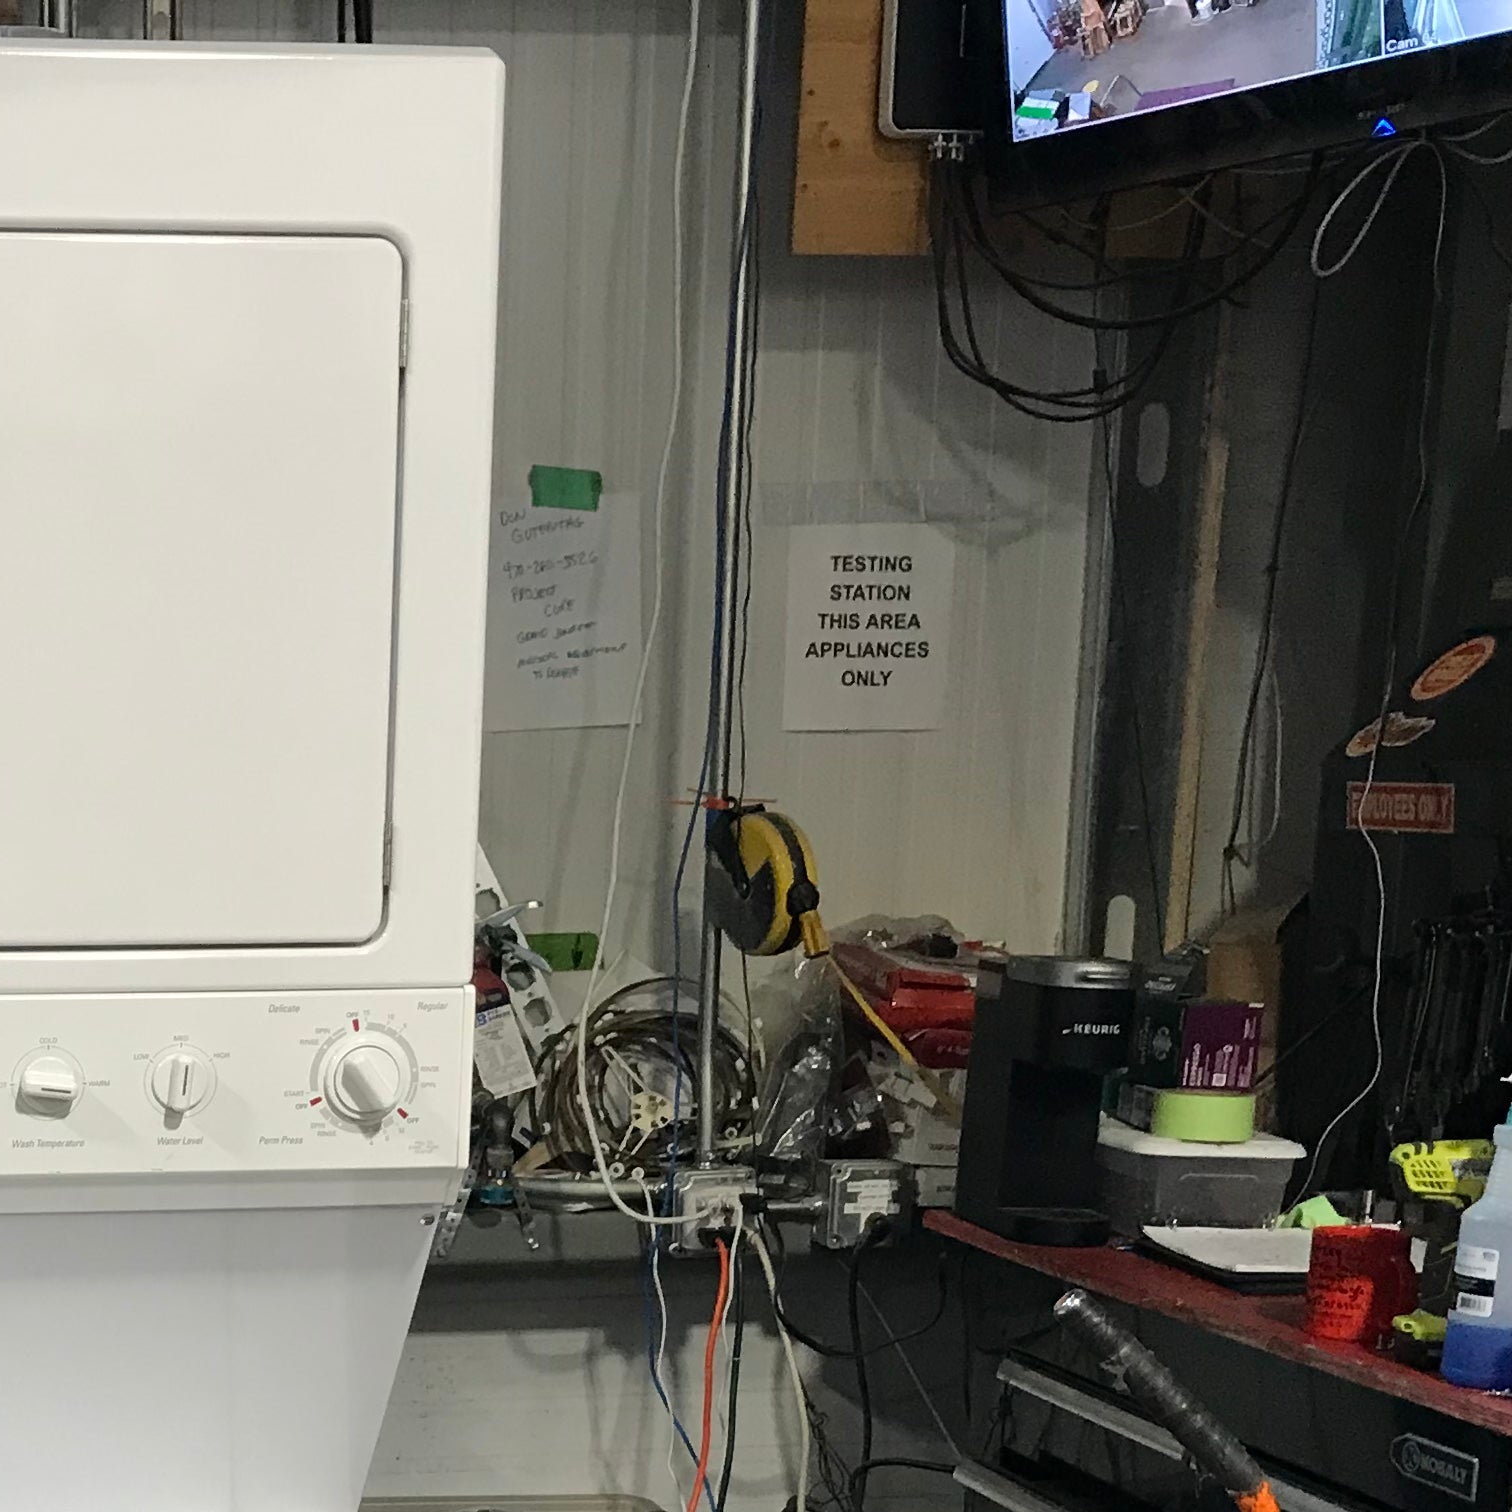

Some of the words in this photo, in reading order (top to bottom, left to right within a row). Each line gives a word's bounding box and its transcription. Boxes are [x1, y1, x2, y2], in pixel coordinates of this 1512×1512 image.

[1386, 37, 1418, 52] Cam
[830, 555, 913, 572] TESTING
[829, 584, 911, 601] STATION
[817, 612, 861, 630] THIS
[865, 612, 921, 630] AREA
[805, 641, 930, 659] APPLIANCES
[840, 670, 893, 687] ONLY
[268, 1004, 301, 1013] Delicate
[417, 1001, 449, 1011] Regular
[1073, 1023, 1121, 1034] KEURIG
[12, 1139, 36, 1148] Wash
[37, 1139, 85, 1149] Temperature
[157, 1137, 181, 1145] Water
[182, 1136, 203, 1145] Level
[259, 1136, 279, 1145] Perm
[280, 1136, 303, 1145] Press
